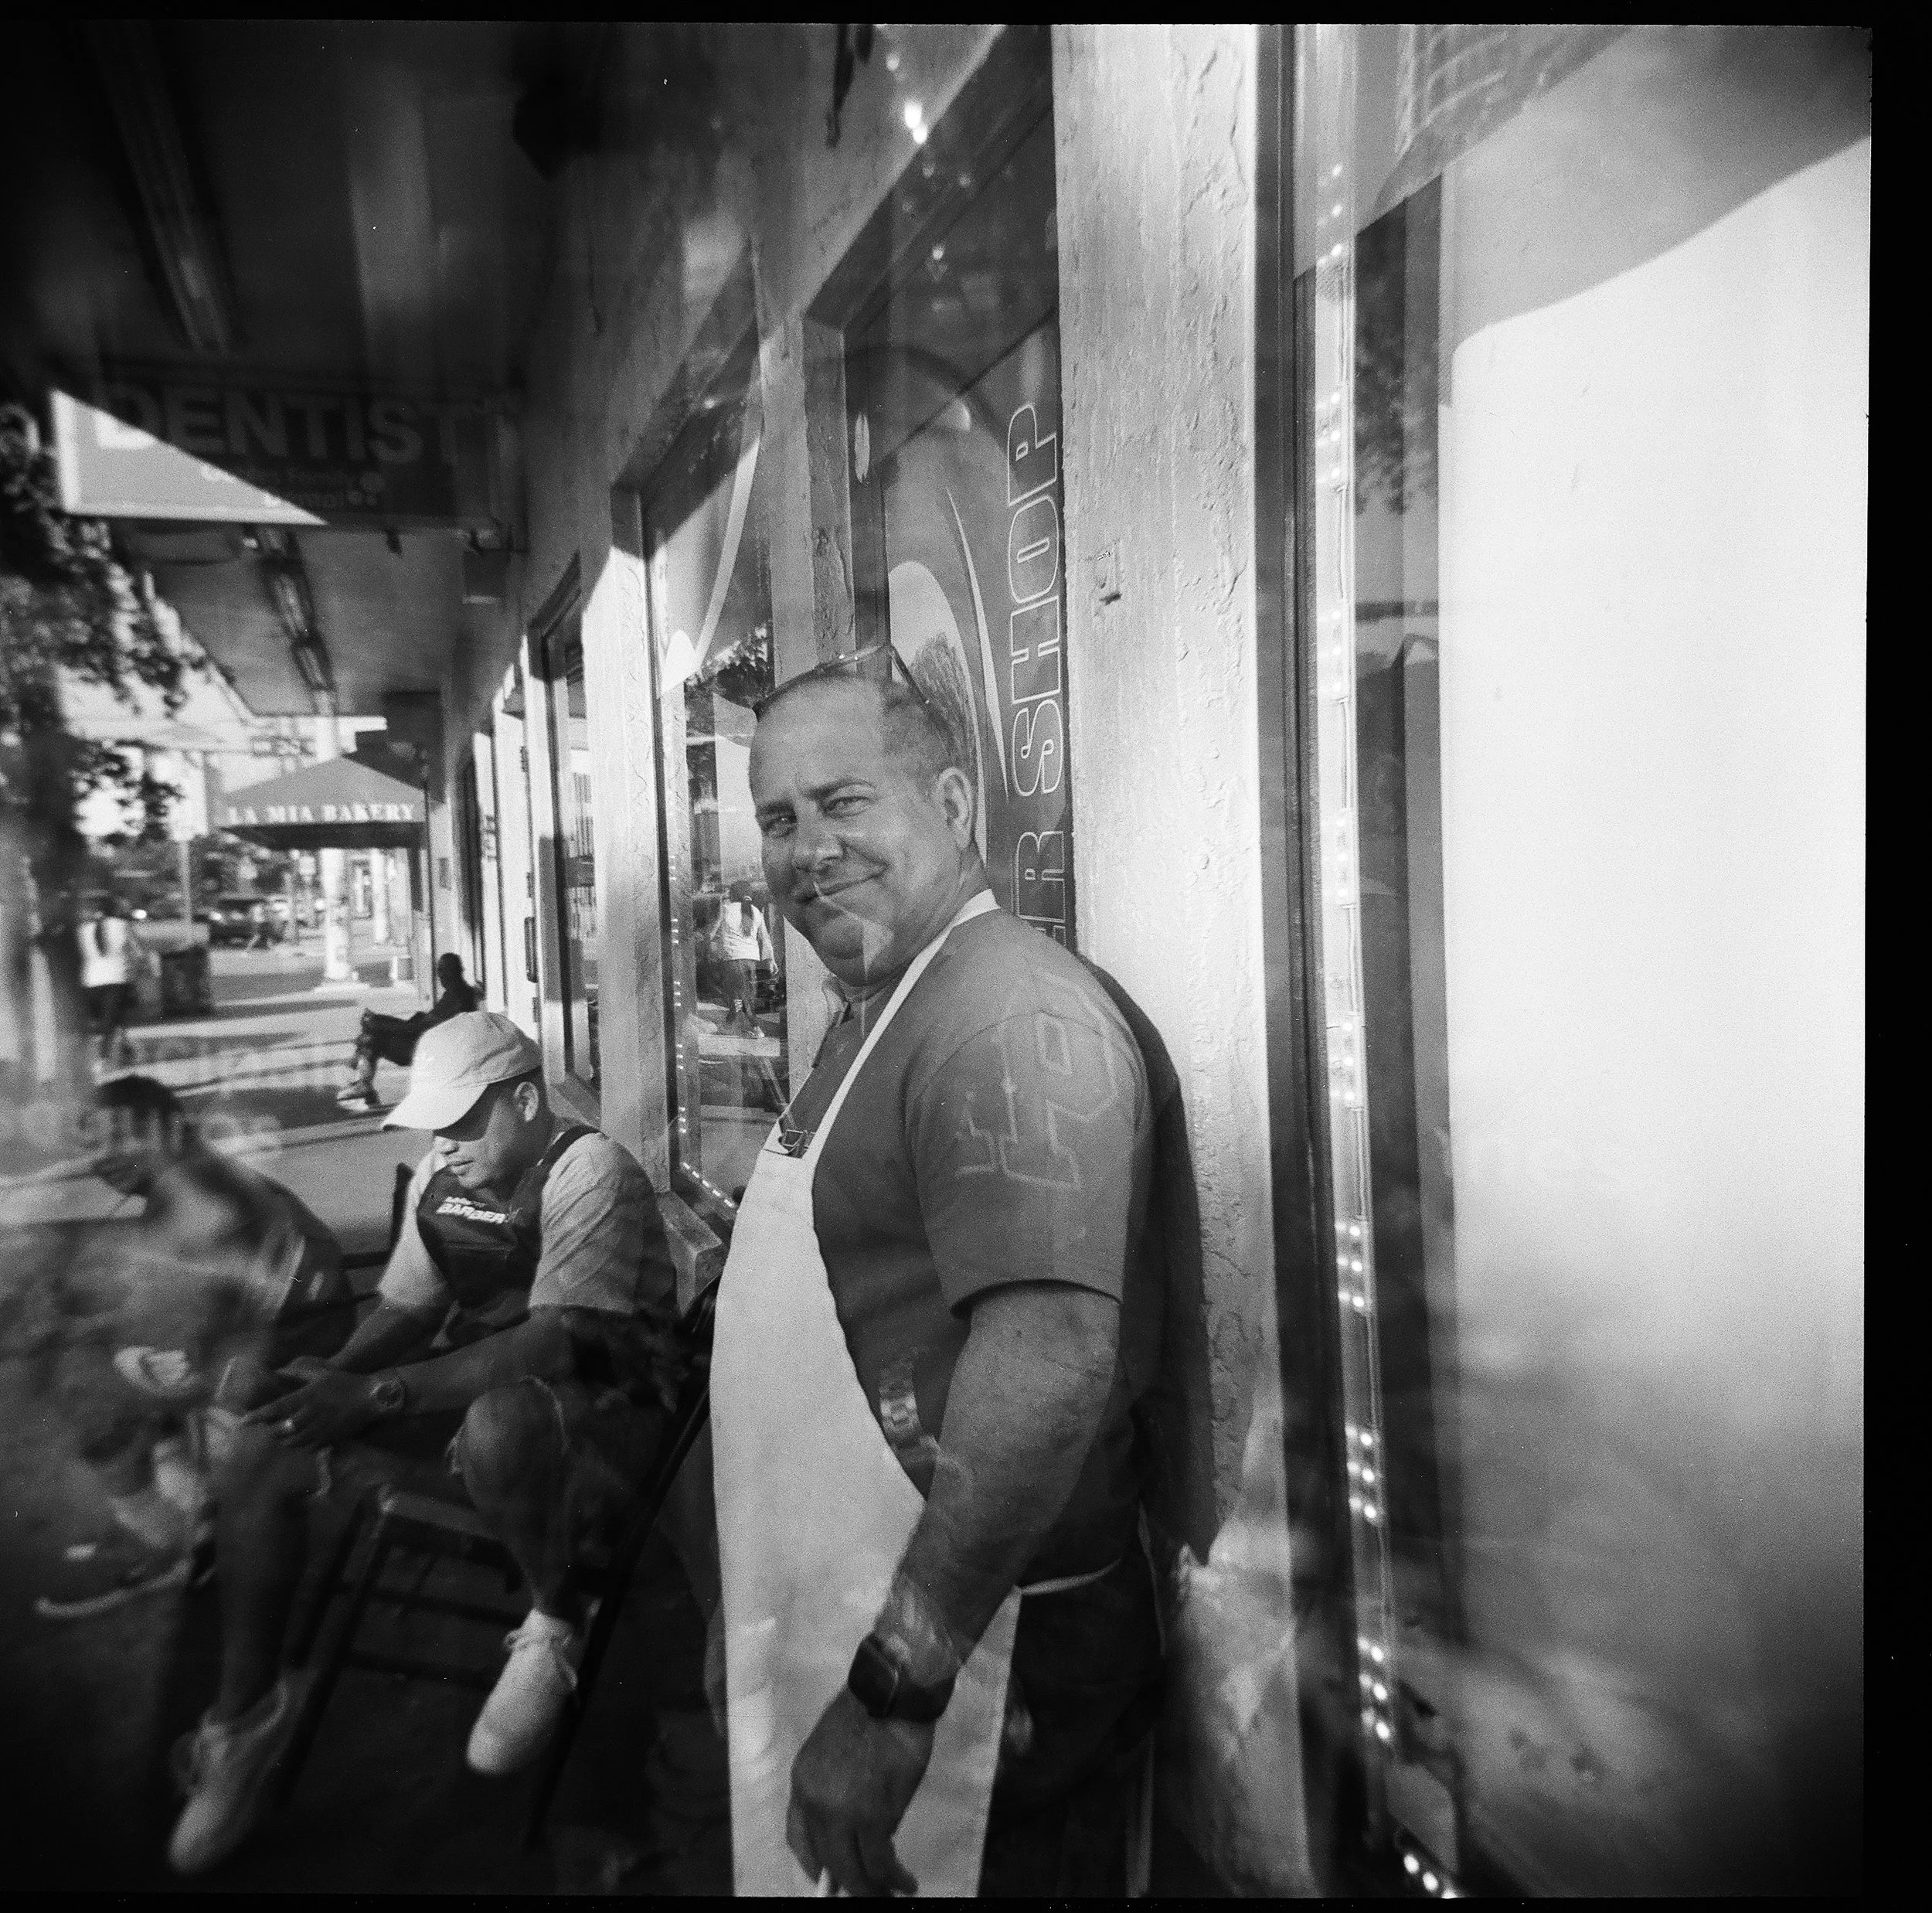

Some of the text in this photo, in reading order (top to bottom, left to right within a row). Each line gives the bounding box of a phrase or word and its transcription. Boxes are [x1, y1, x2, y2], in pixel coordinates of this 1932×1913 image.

[93, 383, 468, 466] DENTIST
[1008, 401, 1063, 797] SHOP
[226, 802, 414, 824] LA MIA BAKERY
[436, 1202, 506, 1224] BARBER
